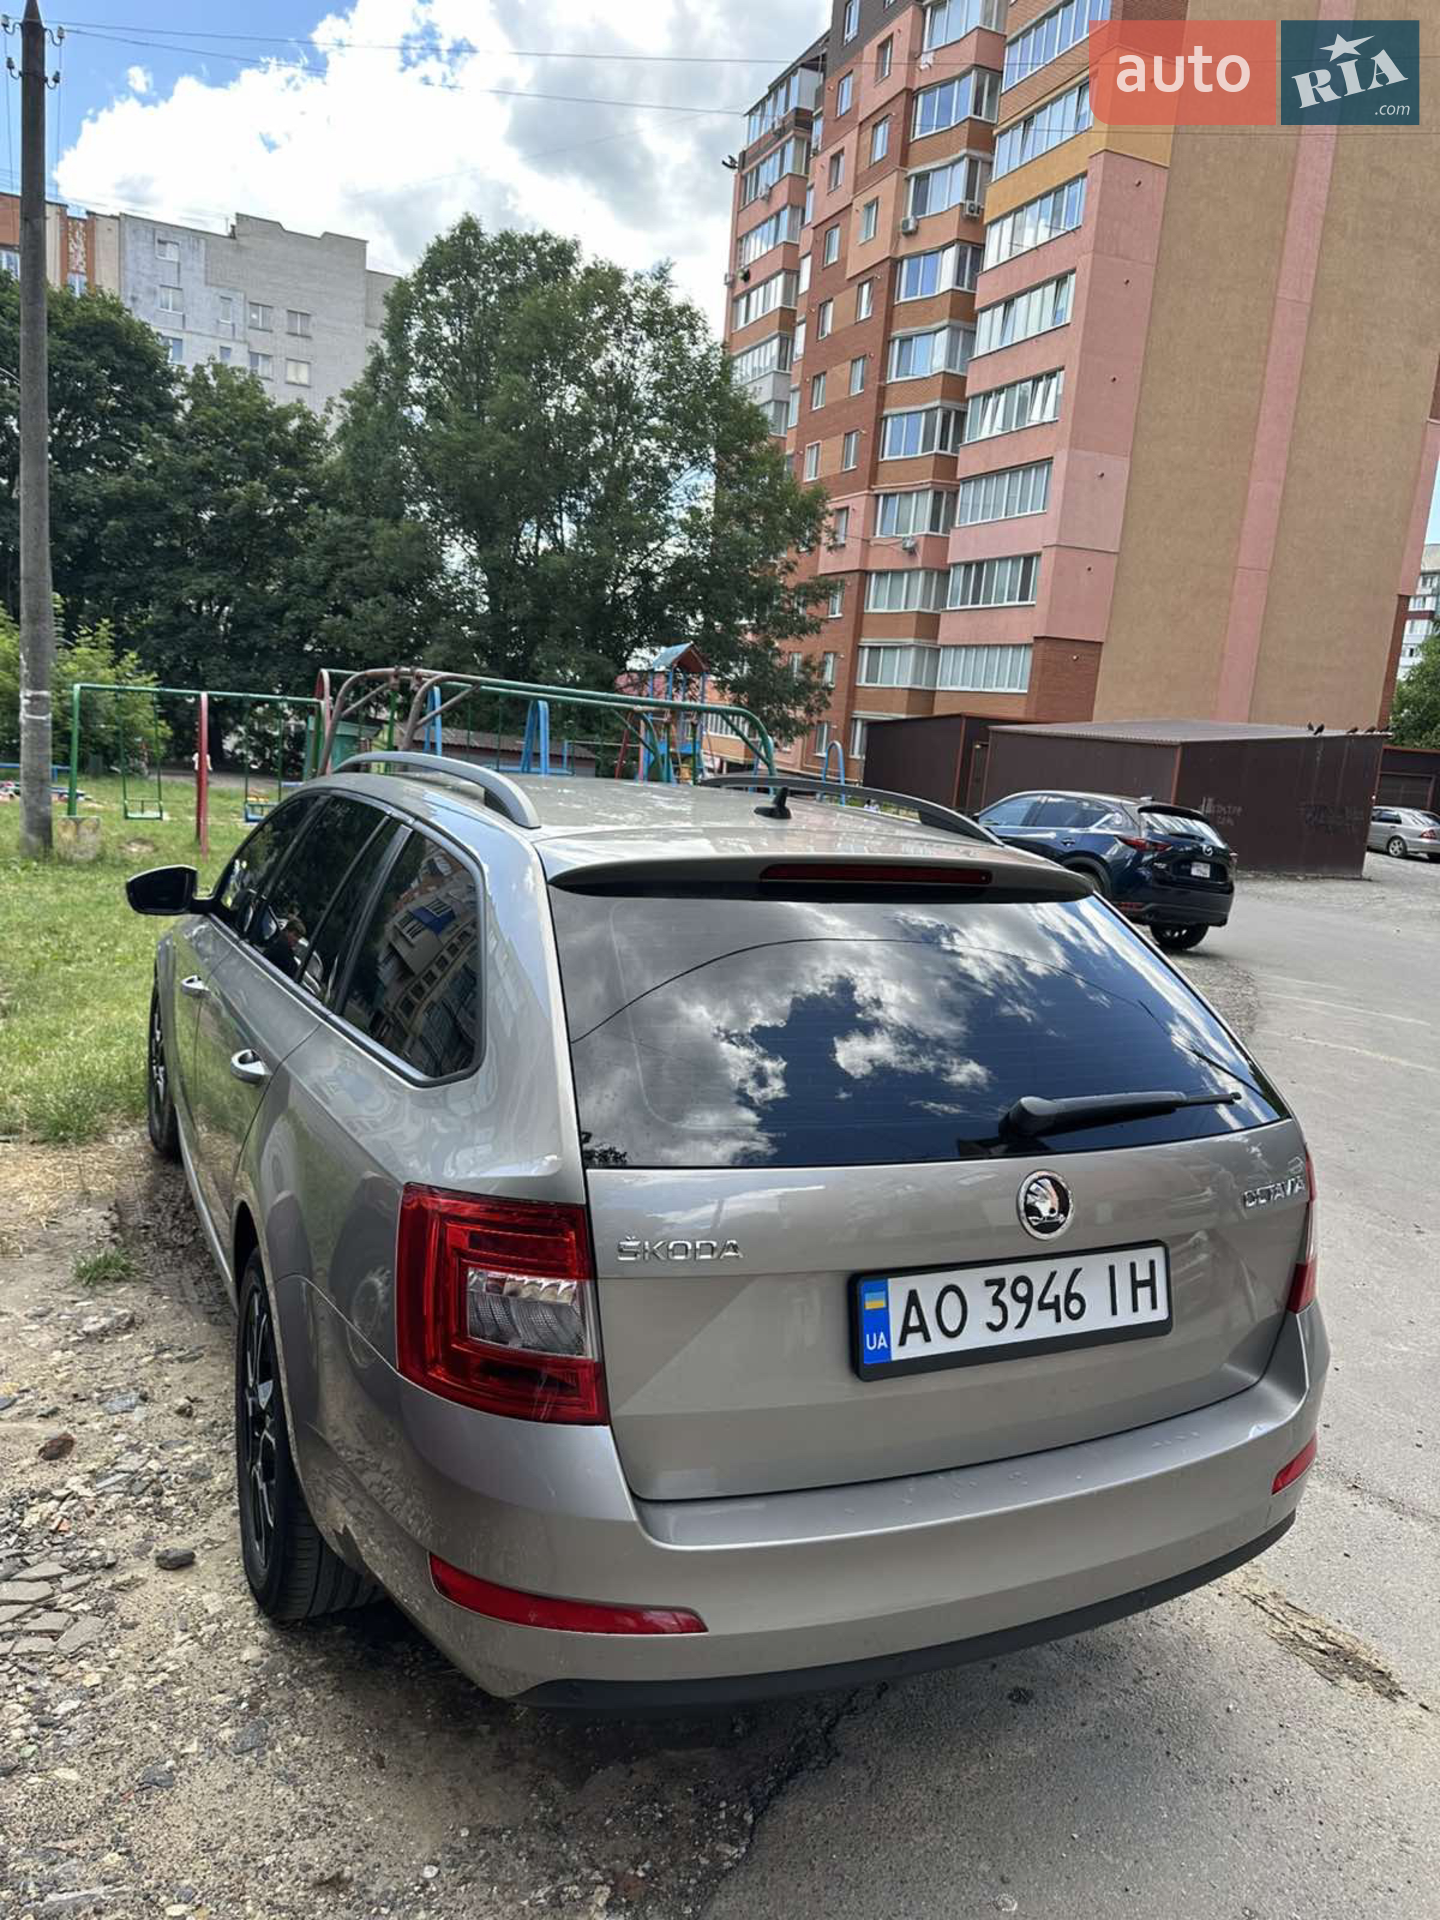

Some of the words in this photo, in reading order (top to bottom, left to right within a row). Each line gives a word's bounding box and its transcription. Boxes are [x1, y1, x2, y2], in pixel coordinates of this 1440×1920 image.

[617, 1236, 743, 1261] ŠKODA
[898, 1283, 968, 1347] AO
[984, 1267, 1087, 1332] 3946
[1108, 1259, 1158, 1316] IH
[866, 1331, 888, 1351] UA
